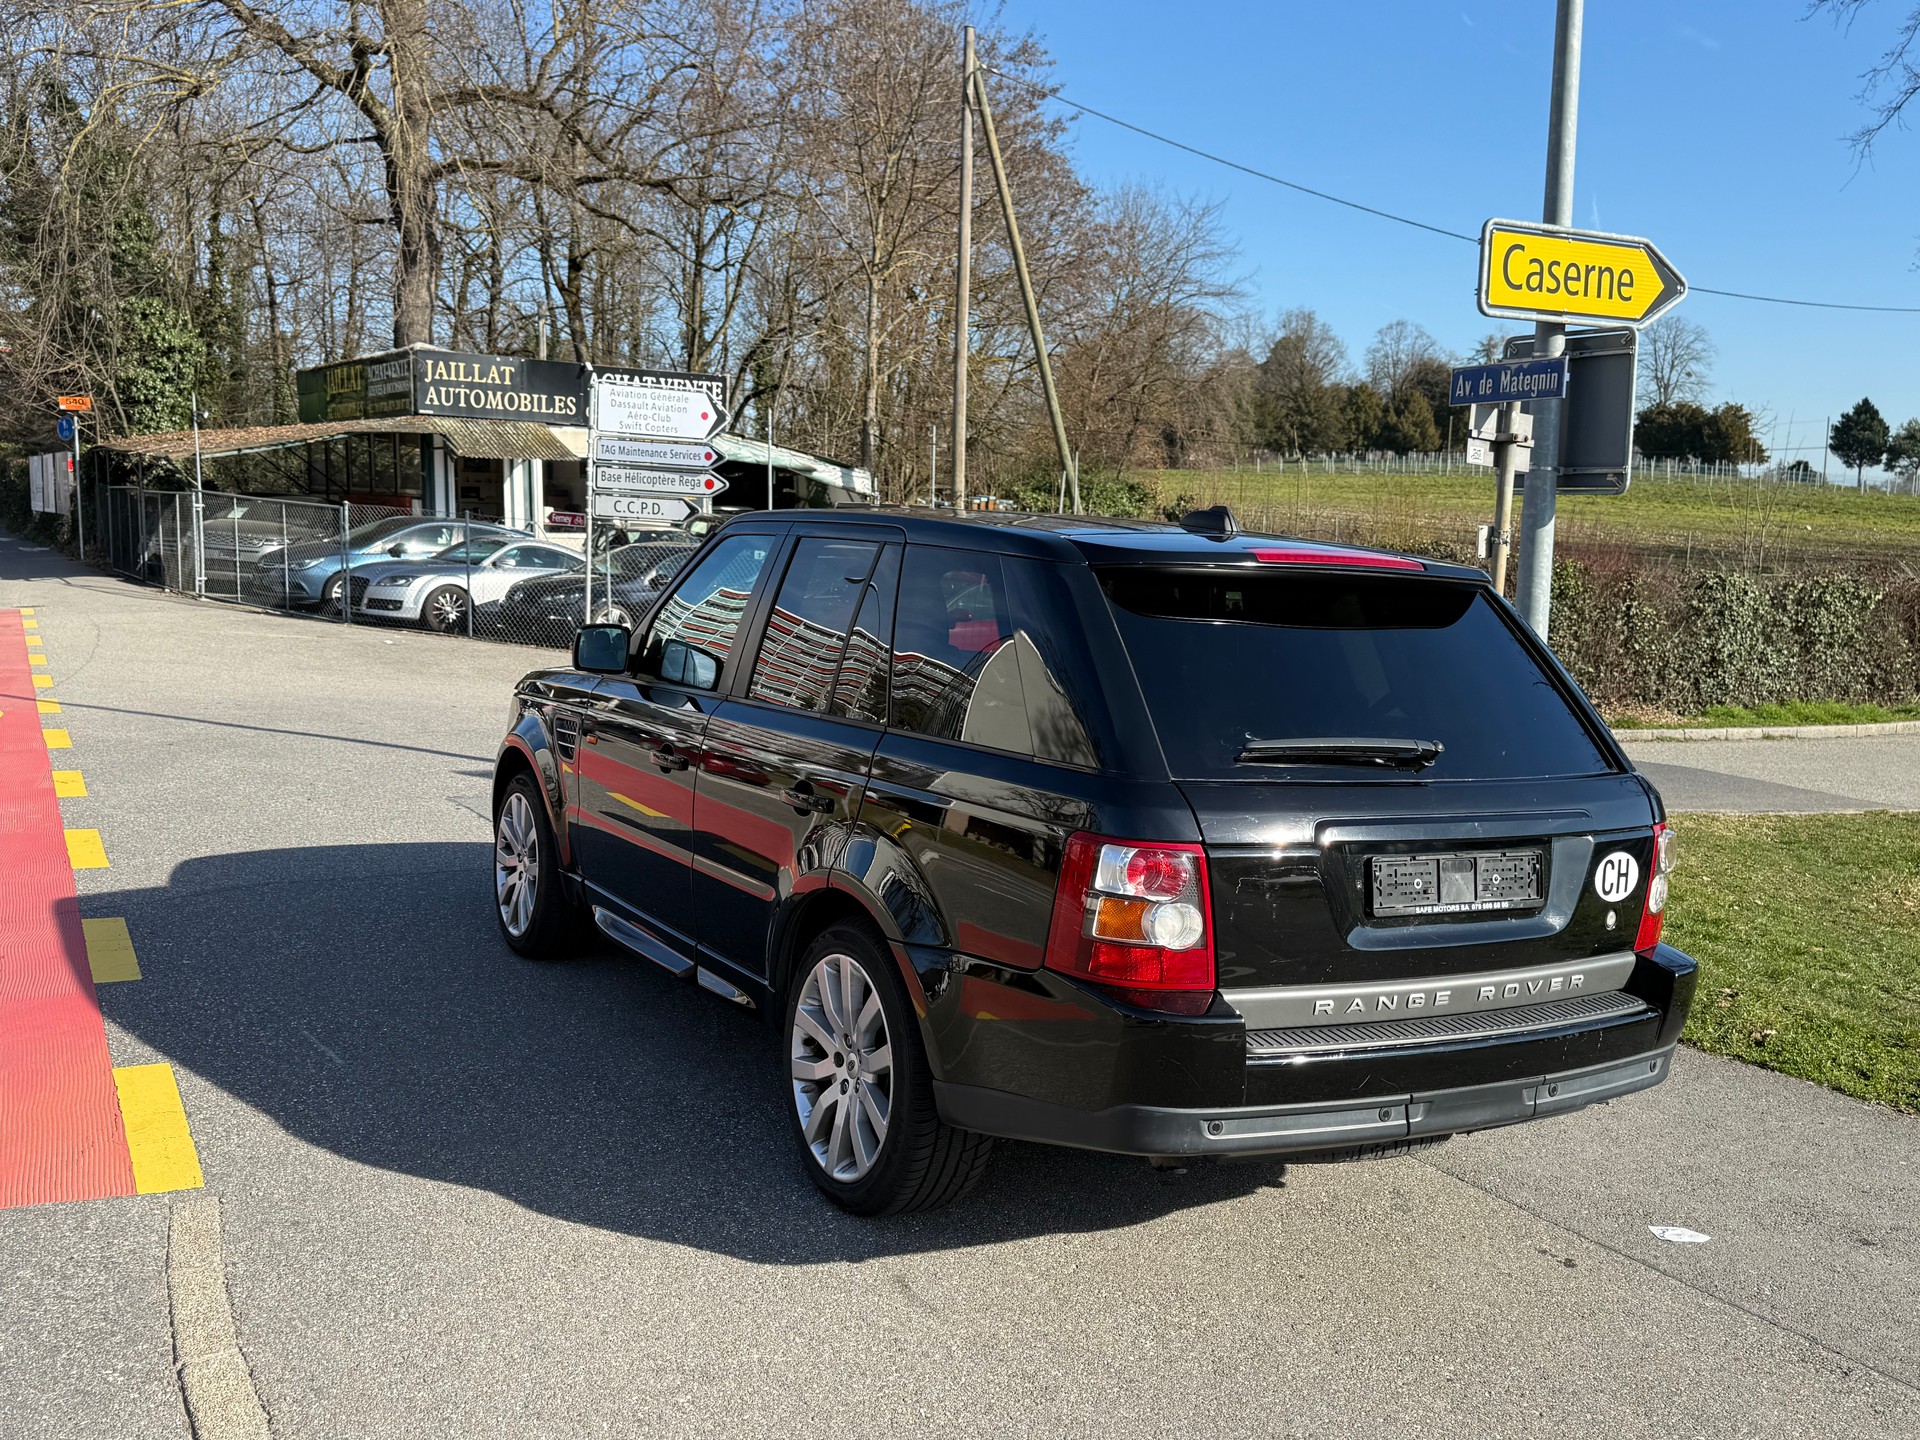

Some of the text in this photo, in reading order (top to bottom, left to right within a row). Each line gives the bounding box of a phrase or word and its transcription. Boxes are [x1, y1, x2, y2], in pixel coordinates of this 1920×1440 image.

[1502, 243, 1634, 302] Caserne
[424, 359, 515, 385] JAILLAT
[326, 364, 363, 401] JAILLAT
[1455, 368, 1559, 397] Av. de Mategnin
[425, 386, 577, 416] AUTOMOBILES
[610, 388, 690, 404] Aviation Générale
[610, 399, 688, 413] Dassault Aviation
[619, 420, 678, 434] Swift Copters
[627, 411, 672, 423] Aéro-Club
[601, 444, 701, 461] TAG Maintenance Services
[601, 470, 701, 490] Base Hélicoptère Rega
[613, 500, 665, 516] C.C.P.D.
[1601, 858, 1631, 899] CH
[1415, 905, 1432, 914] SAFE
[1433, 904, 1460, 913] MOTORS
[1461, 903, 1470, 911] SA
[1313, 974, 1585, 1016] RANGE ROVER
